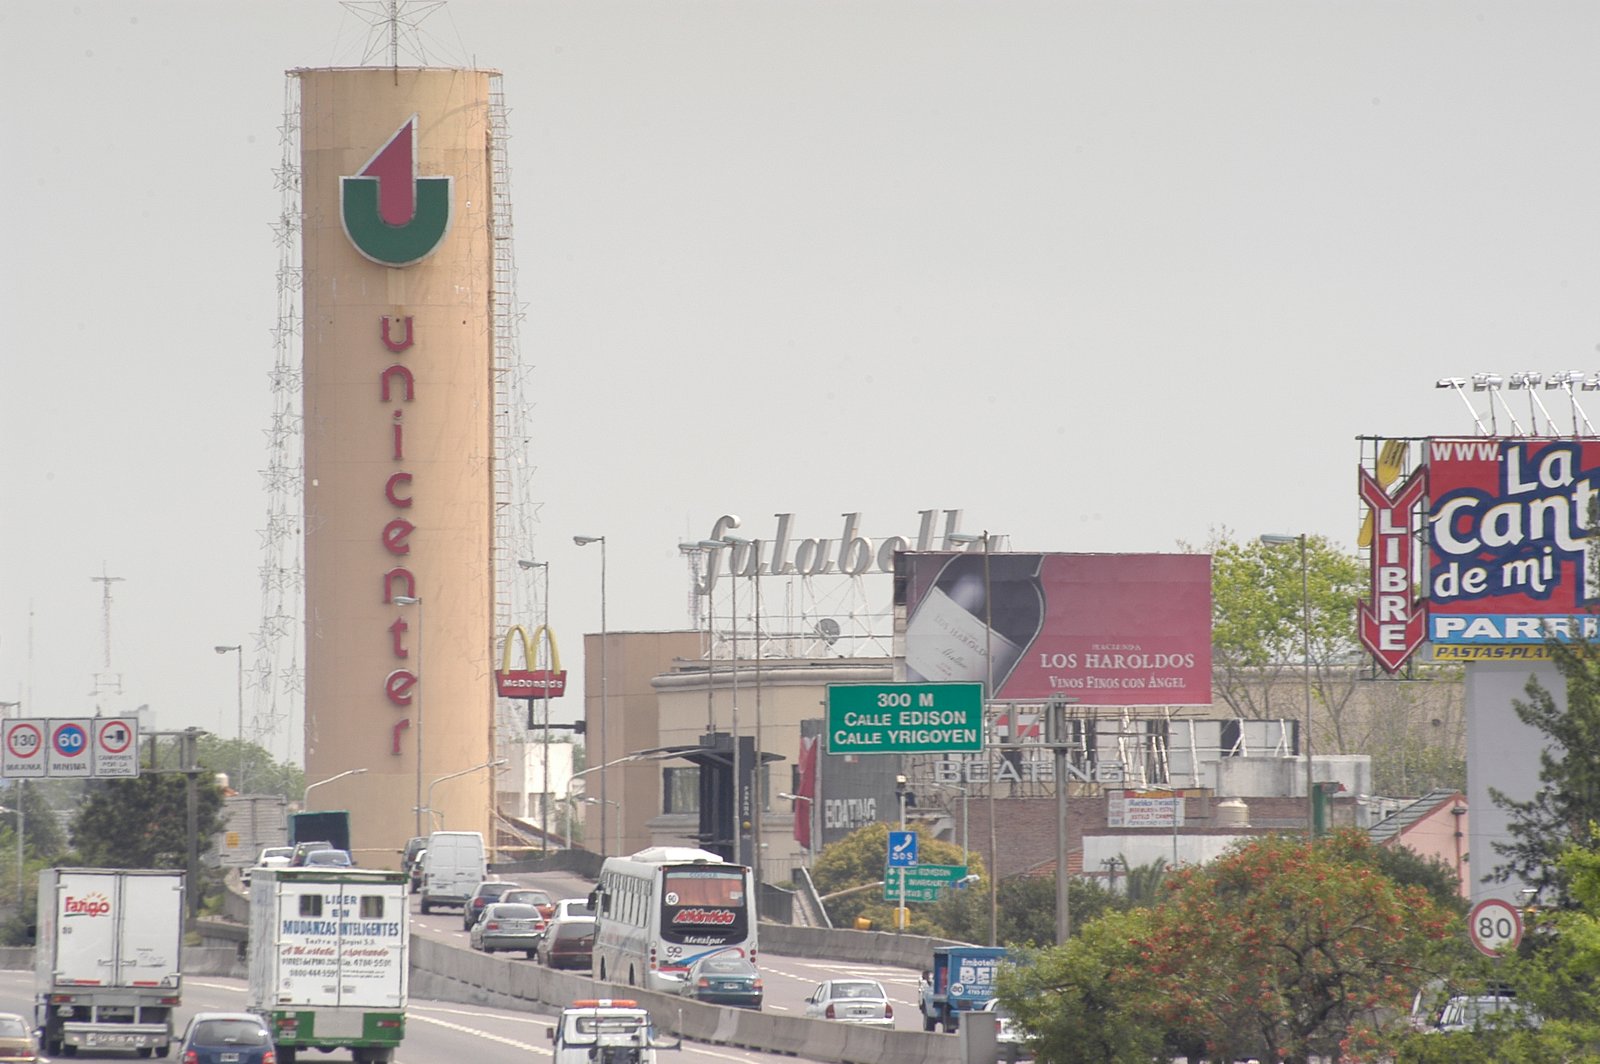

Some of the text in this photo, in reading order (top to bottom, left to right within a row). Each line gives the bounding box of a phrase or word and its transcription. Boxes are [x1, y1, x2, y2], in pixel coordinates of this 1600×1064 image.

[1507, 446, 1575, 495] La
[380, 315, 418, 758] unicenter
[1434, 563, 1488, 597] de
[1502, 546, 1553, 592] mi
[1379, 508, 1408, 651] LIBRE
[1040, 653, 1195, 669] LOS HAROLDOS
[877, 693, 934, 707] 300 M
[899, 711, 967, 725] EDISON
[13, 734, 36, 746] 130
[58, 733, 82, 747] 60
[888, 729, 977, 744] YRIGOYEN
[325, 895, 357, 905] LIDER
[331, 909, 350, 917] EN
[282, 920, 399, 937] MUDANZAS INTELIGENTES
[1479, 917, 1512, 939] 80
